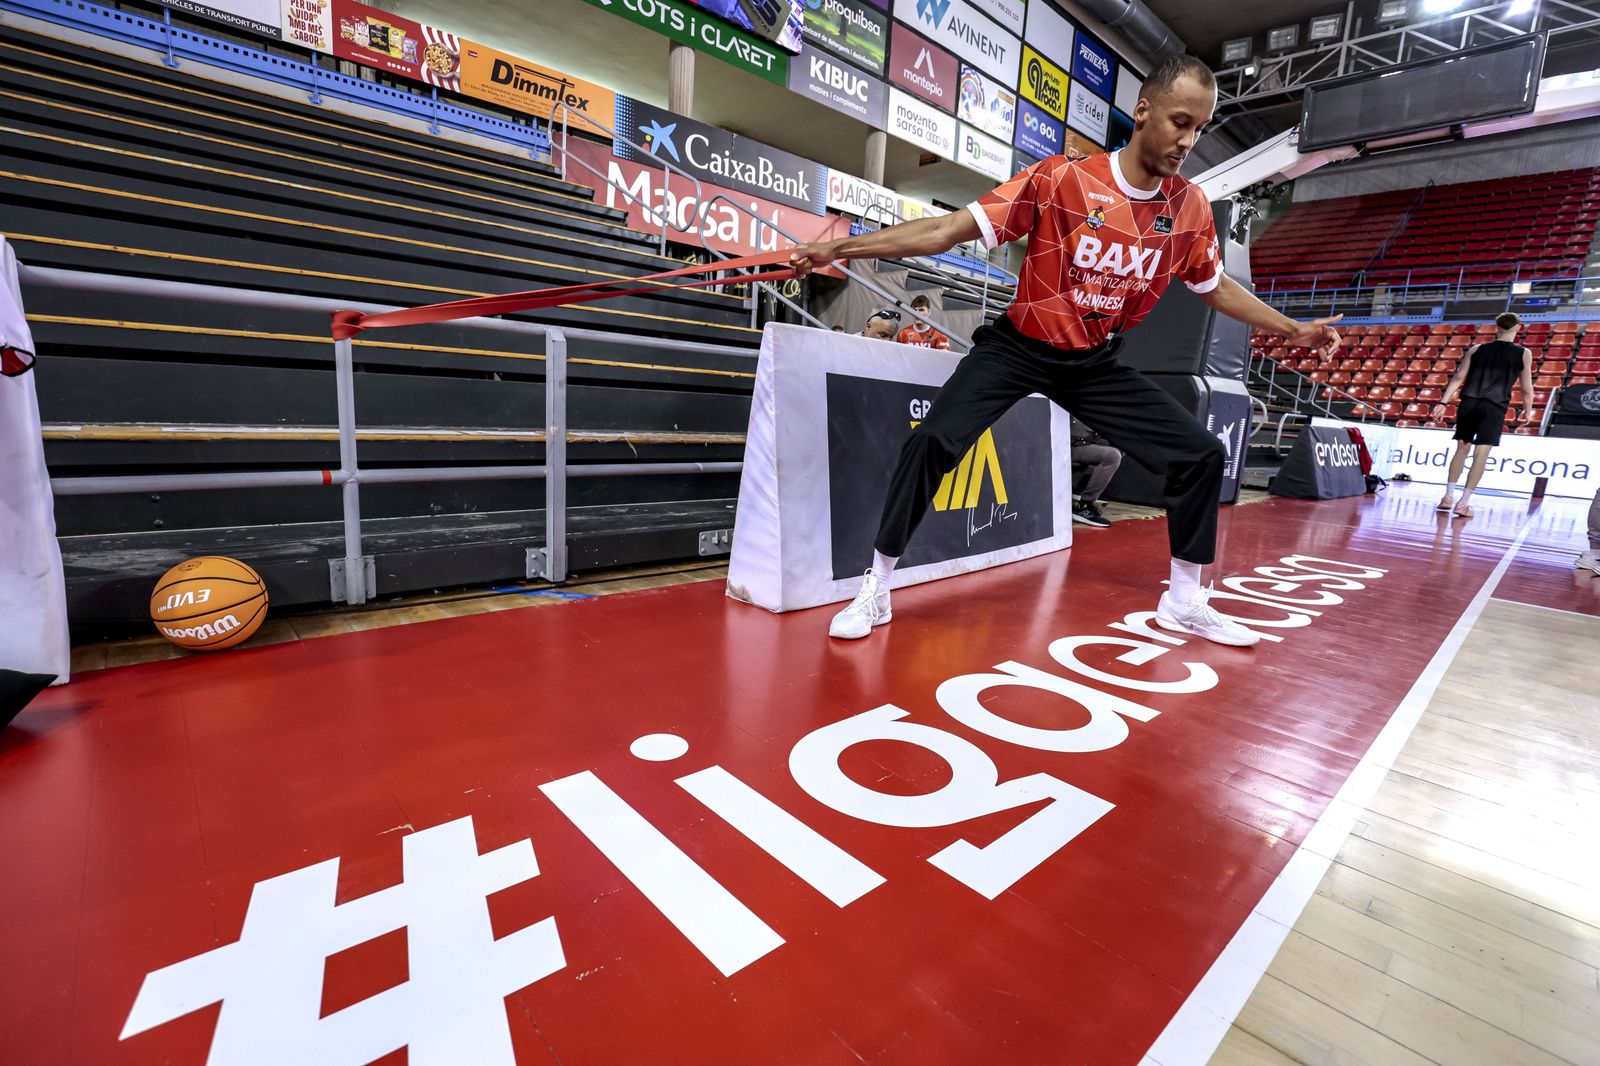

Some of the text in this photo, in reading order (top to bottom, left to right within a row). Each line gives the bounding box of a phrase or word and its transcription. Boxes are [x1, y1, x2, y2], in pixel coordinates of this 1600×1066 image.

[194, 5, 206, 14] DE
[206, 9, 250, 28] TRANSPORT
[251, 23, 277, 36] PÚBLIC
[296, 8, 314, 22] VIDA
[306, 1, 322, 14] UNA
[824, 0, 881, 37] proquibsa
[289, 18, 306, 32] AMB
[294, 30, 319, 46] SABOR
[700, 24, 776, 71] CLARET
[947, 15, 1006, 65] AVINENT
[810, 55, 869, 103] KIBUC
[903, 68, 943, 97] montepio
[833, 95, 867, 115] complements
[897, 105, 938, 132] movento
[1085, 102, 1105, 123] cidet
[896, 117, 923, 138] sarsa
[1040, 122, 1057, 143] GOL
[684, 133, 811, 202] CaixaBank
[606, 160, 779, 252] Macsa id
[1072, 233, 1163, 281] BAXI
[1073, 287, 1126, 311] MANRESA
[1314, 436, 1361, 467] endesa
[163, 614, 241, 640] Wilson
